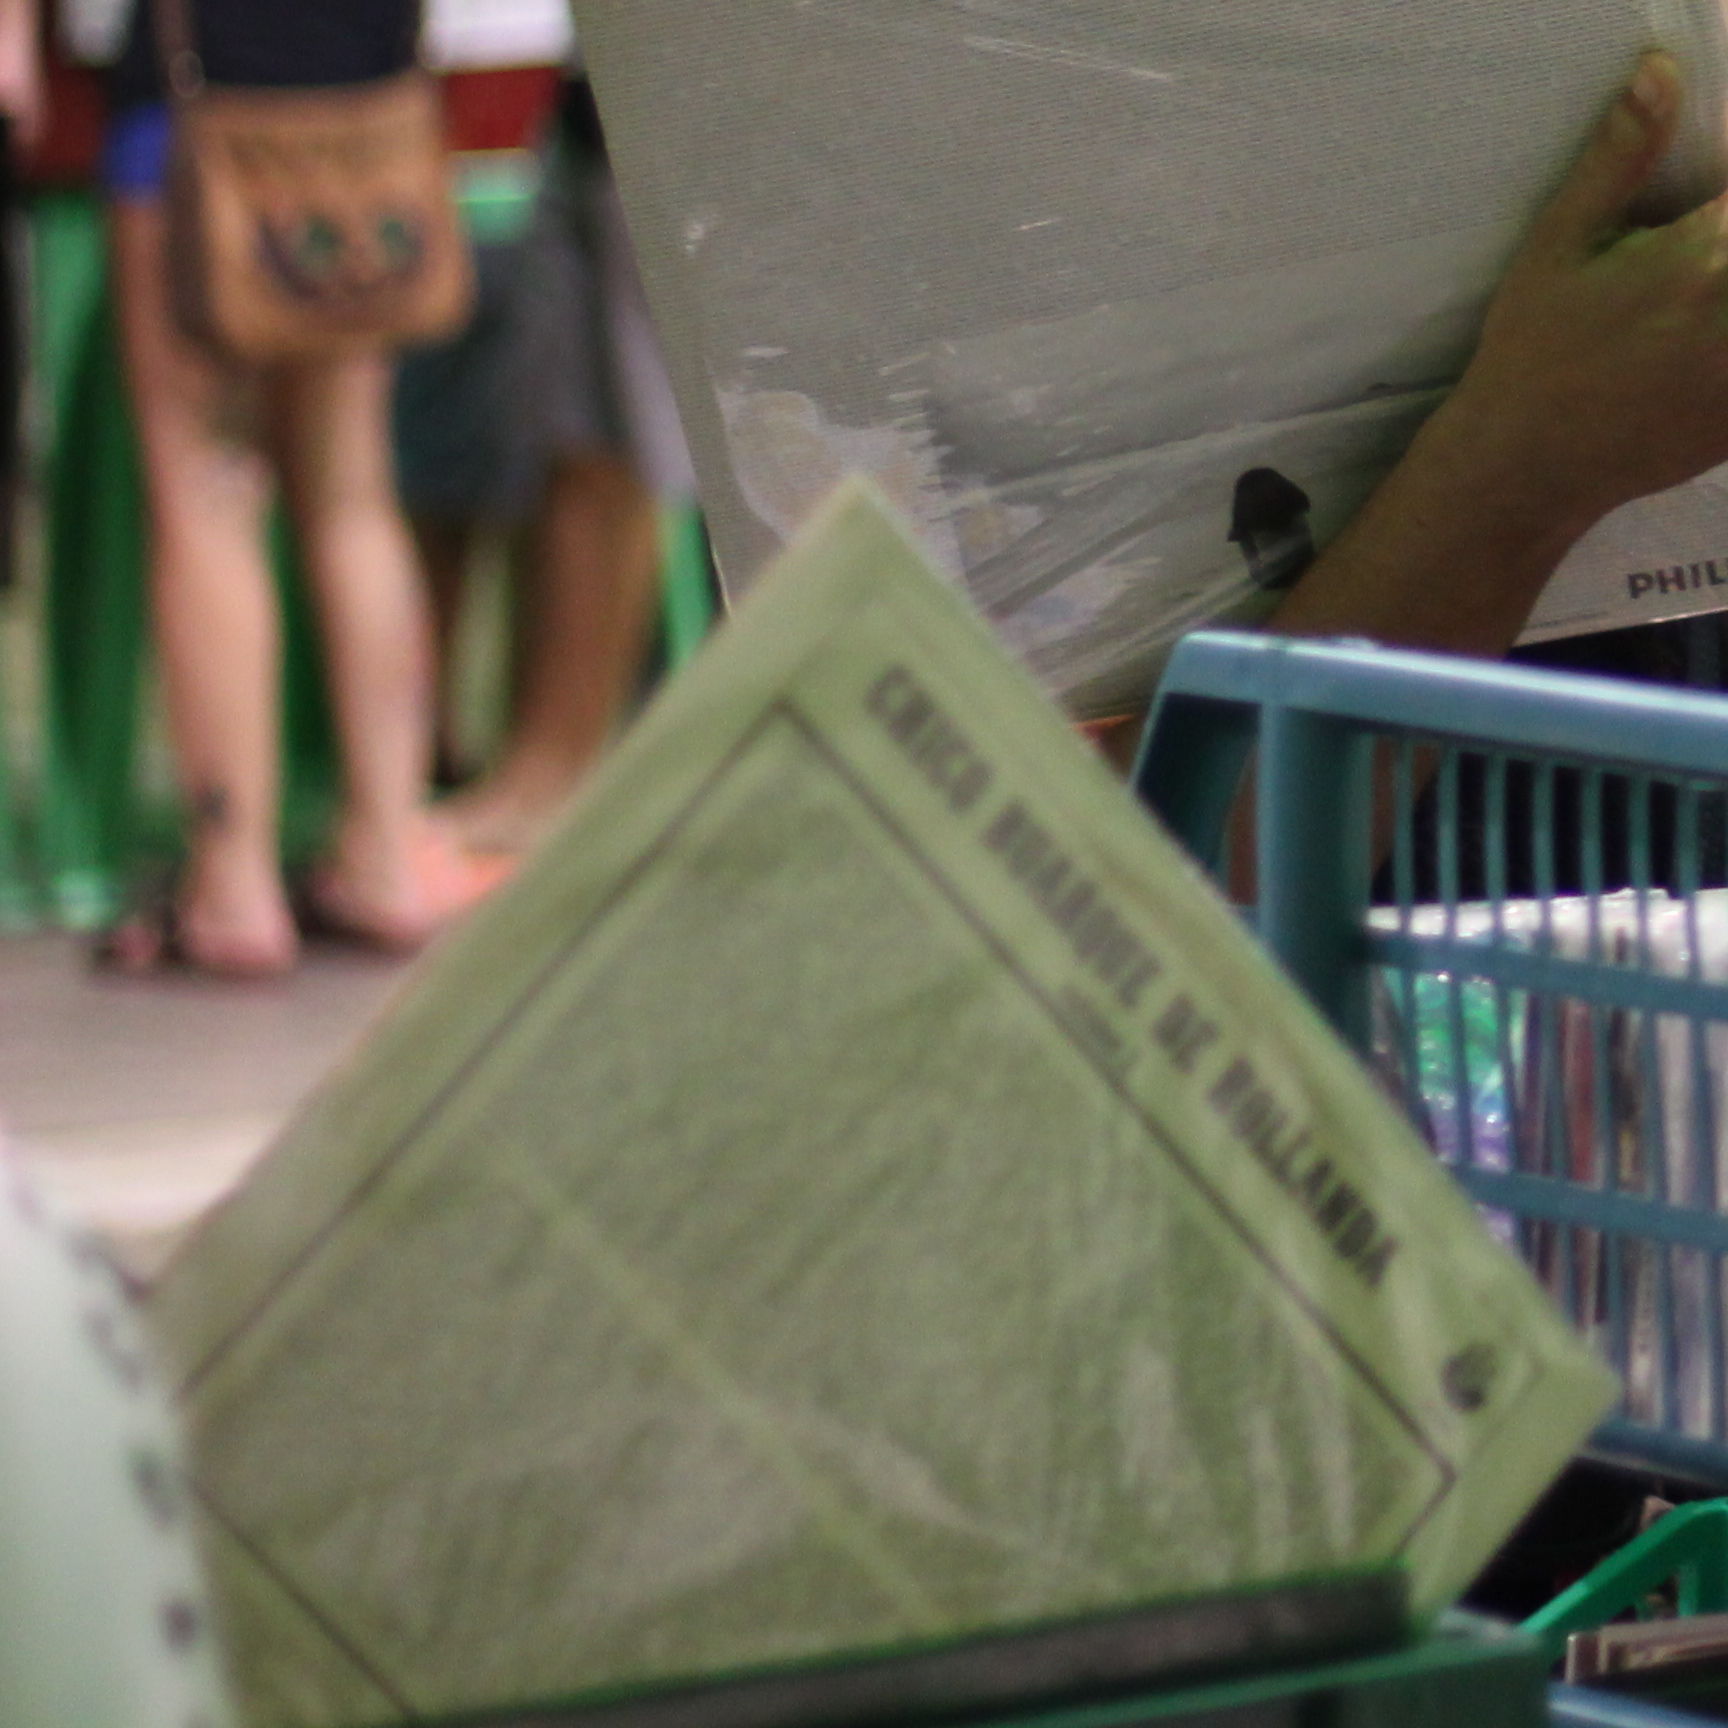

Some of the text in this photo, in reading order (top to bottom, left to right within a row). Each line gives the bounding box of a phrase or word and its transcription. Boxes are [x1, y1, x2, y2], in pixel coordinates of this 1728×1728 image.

[864, 664, 996, 815] CHICO
[980, 800, 1161, 1010] BUARQUE
[1152, 993, 1219, 1073] DE
[1207, 1057, 1397, 1288] HOLLANDA
